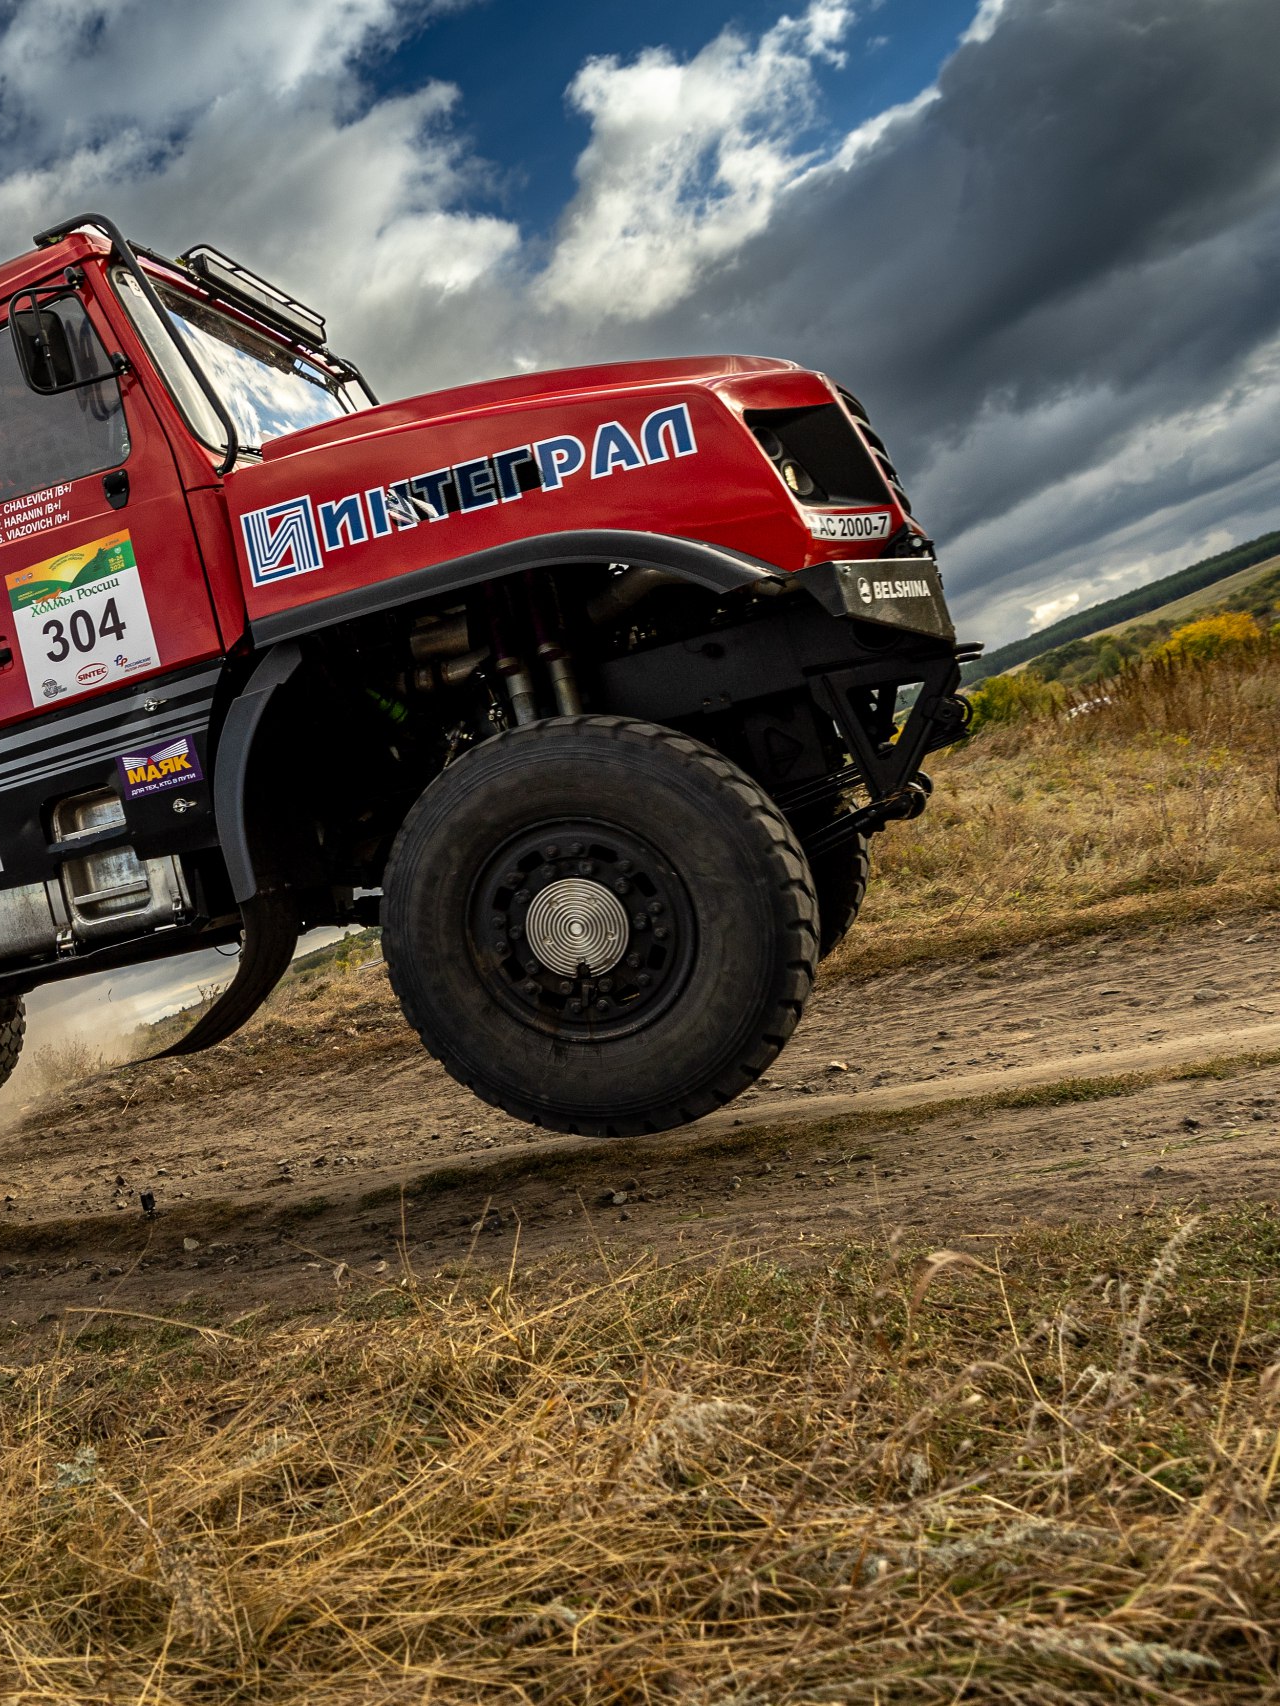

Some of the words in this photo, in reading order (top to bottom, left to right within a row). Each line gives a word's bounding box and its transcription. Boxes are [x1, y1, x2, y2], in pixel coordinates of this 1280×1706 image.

[3, 489, 53, 514] CHALEVICH
[54, 482, 73, 498] /B+/
[4, 507, 43, 529] HARANIN
[44, 499, 62, 515] /B+/
[838, 515, 888, 537] 2000-7
[6, 516, 53, 541] VIAZOVICH
[76, 577, 120, 600] России
[872, 579, 932, 600] BELSHINA
[42, 597, 127, 663] 304
[77, 666, 107, 682] SINTEC
[126, 752, 193, 785] МАЯК
[131, 787, 145, 796] ДЛЯ
[159, 779, 173, 788] КТО
[177, 772, 197, 783] ПУТИ
